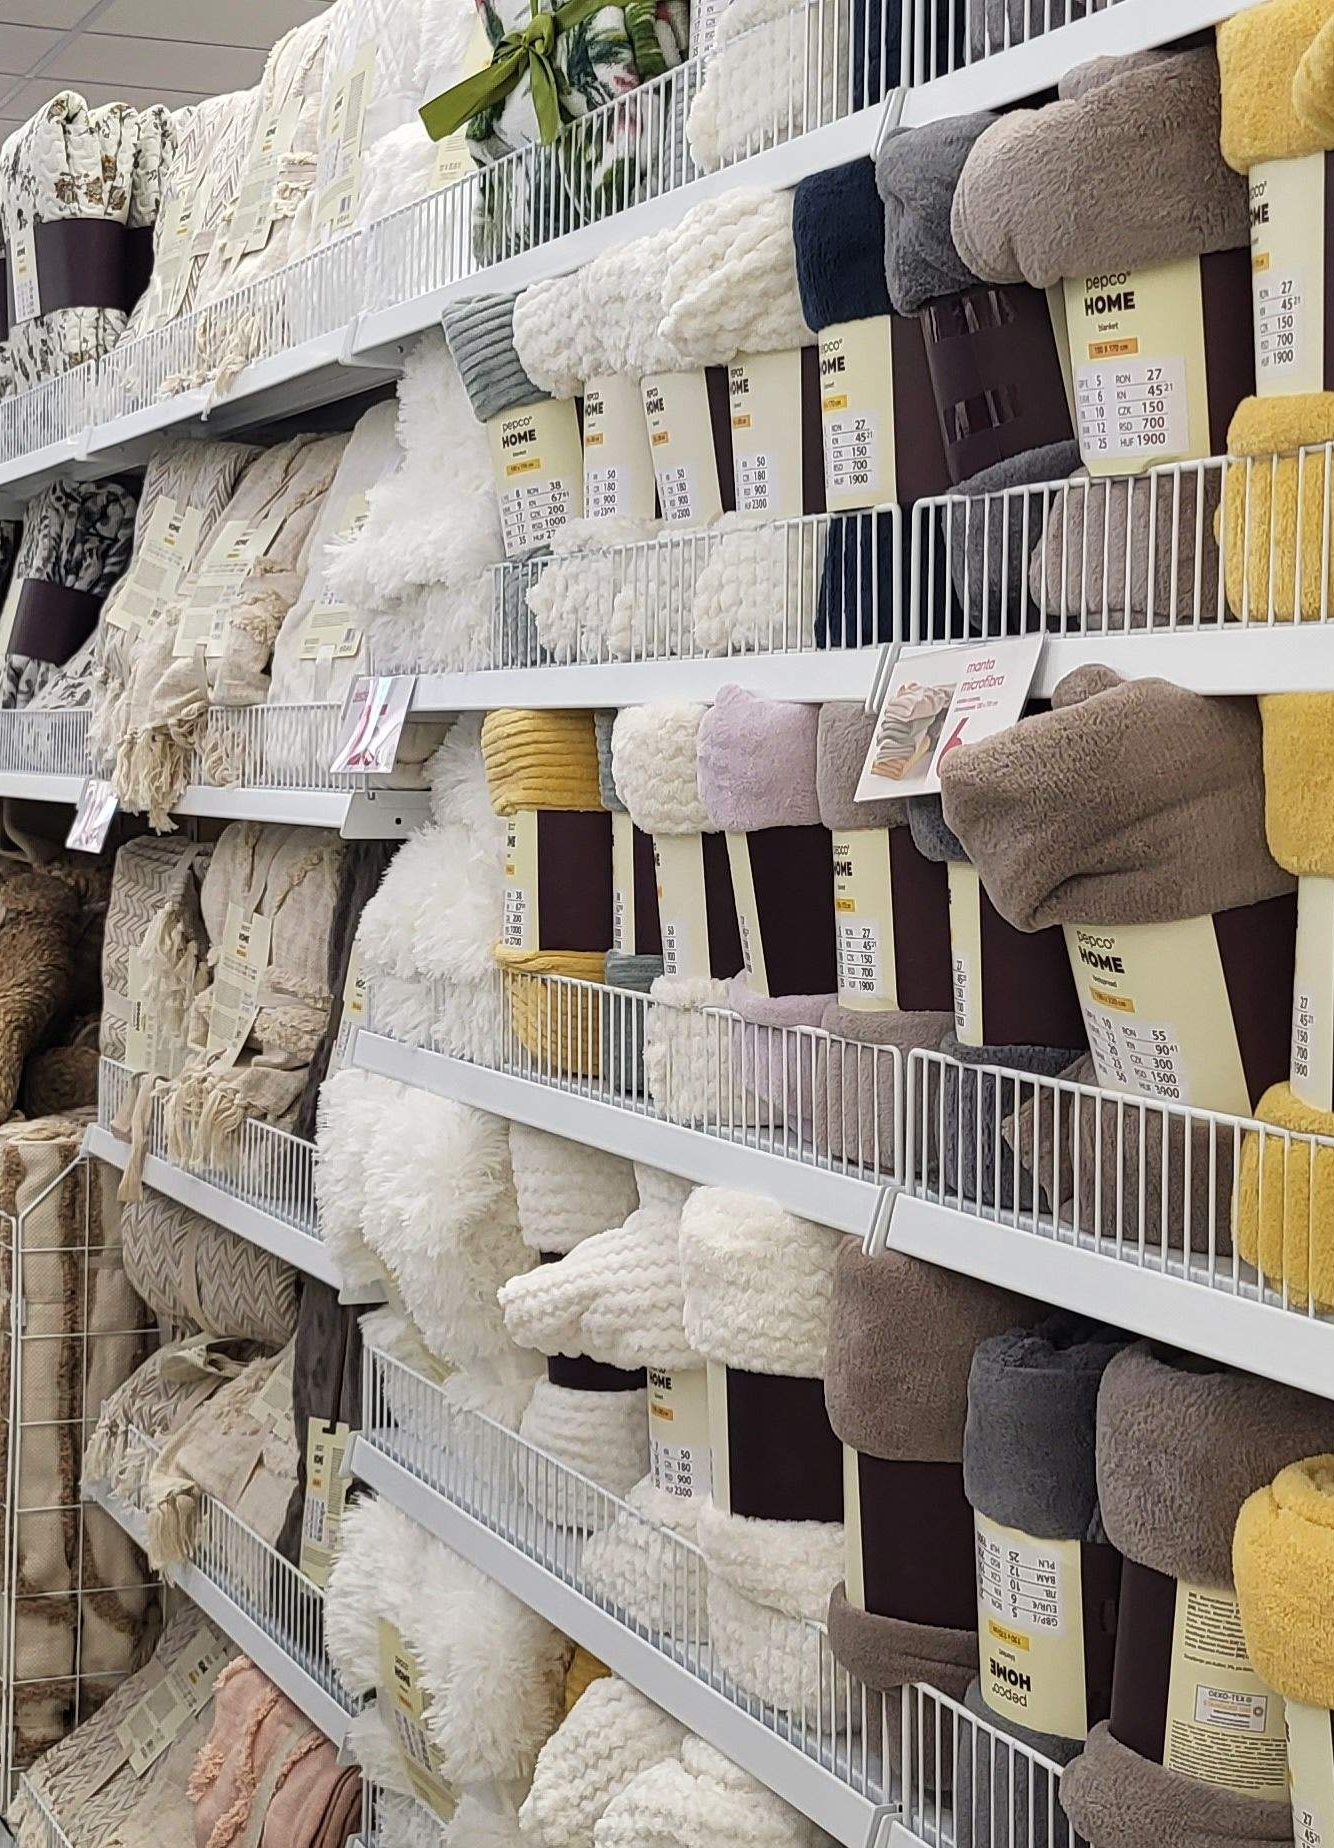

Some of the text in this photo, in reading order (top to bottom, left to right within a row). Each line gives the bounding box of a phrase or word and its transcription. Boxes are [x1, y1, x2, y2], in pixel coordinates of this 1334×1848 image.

[1281, 281, 1292, 294] 27
[1084, 291, 1135, 316] HOME
[1278, 316, 1293, 329] 150
[1277, 332, 1293, 346] 700
[1273, 349, 1293, 364] 1900
[821, 356, 845, 375] OME
[1116, 369, 1162, 384] RON 27
[1096, 407, 1104, 418] 10
[1118, 401, 1164, 416] CZK 150
[855, 420, 865, 430] 27
[1097, 422, 1105, 433] 12
[1119, 418, 1164, 431] RSD 700
[502, 429, 537, 448] HOME
[1098, 438, 1107, 449] 25
[1120, 433, 1165, 447] HUF 1900
[852, 447, 867, 457] 150
[757, 457, 765, 466] 50
[852, 460, 867, 470] 700
[754, 471, 766, 480] 180
[849, 474, 868, 485] 1900
[754, 485, 766, 494] 900
[752, 499, 767, 508] 2300
[548, 505, 564, 515] 200
[545, 516, 566, 526] 1000
[967, 659, 995, 673] manta
[961, 675, 1004, 692] microfibra
[1078, 946, 1125, 974] HOME
[1153, 1030, 1166, 1041] 55
[1153, 1058, 1173, 1070] 300
[1151, 1071, 1176, 1084] 1500
[1155, 1085, 1179, 1098] 3900
[681, 1450, 690, 1460] 50
[677, 1462, 691, 1472] 180
[677, 1474, 691, 1484] 900
[675, 1486, 692, 1497] 2300
[1009, 1551, 1055, 1570] PLN 25
[1010, 1565, 1056, 1584] BAM 12
[1010, 1580, 1020, 1591] 10
[990, 1657, 1031, 1692] HOME
[1303, 1812, 1312, 1826] 27
